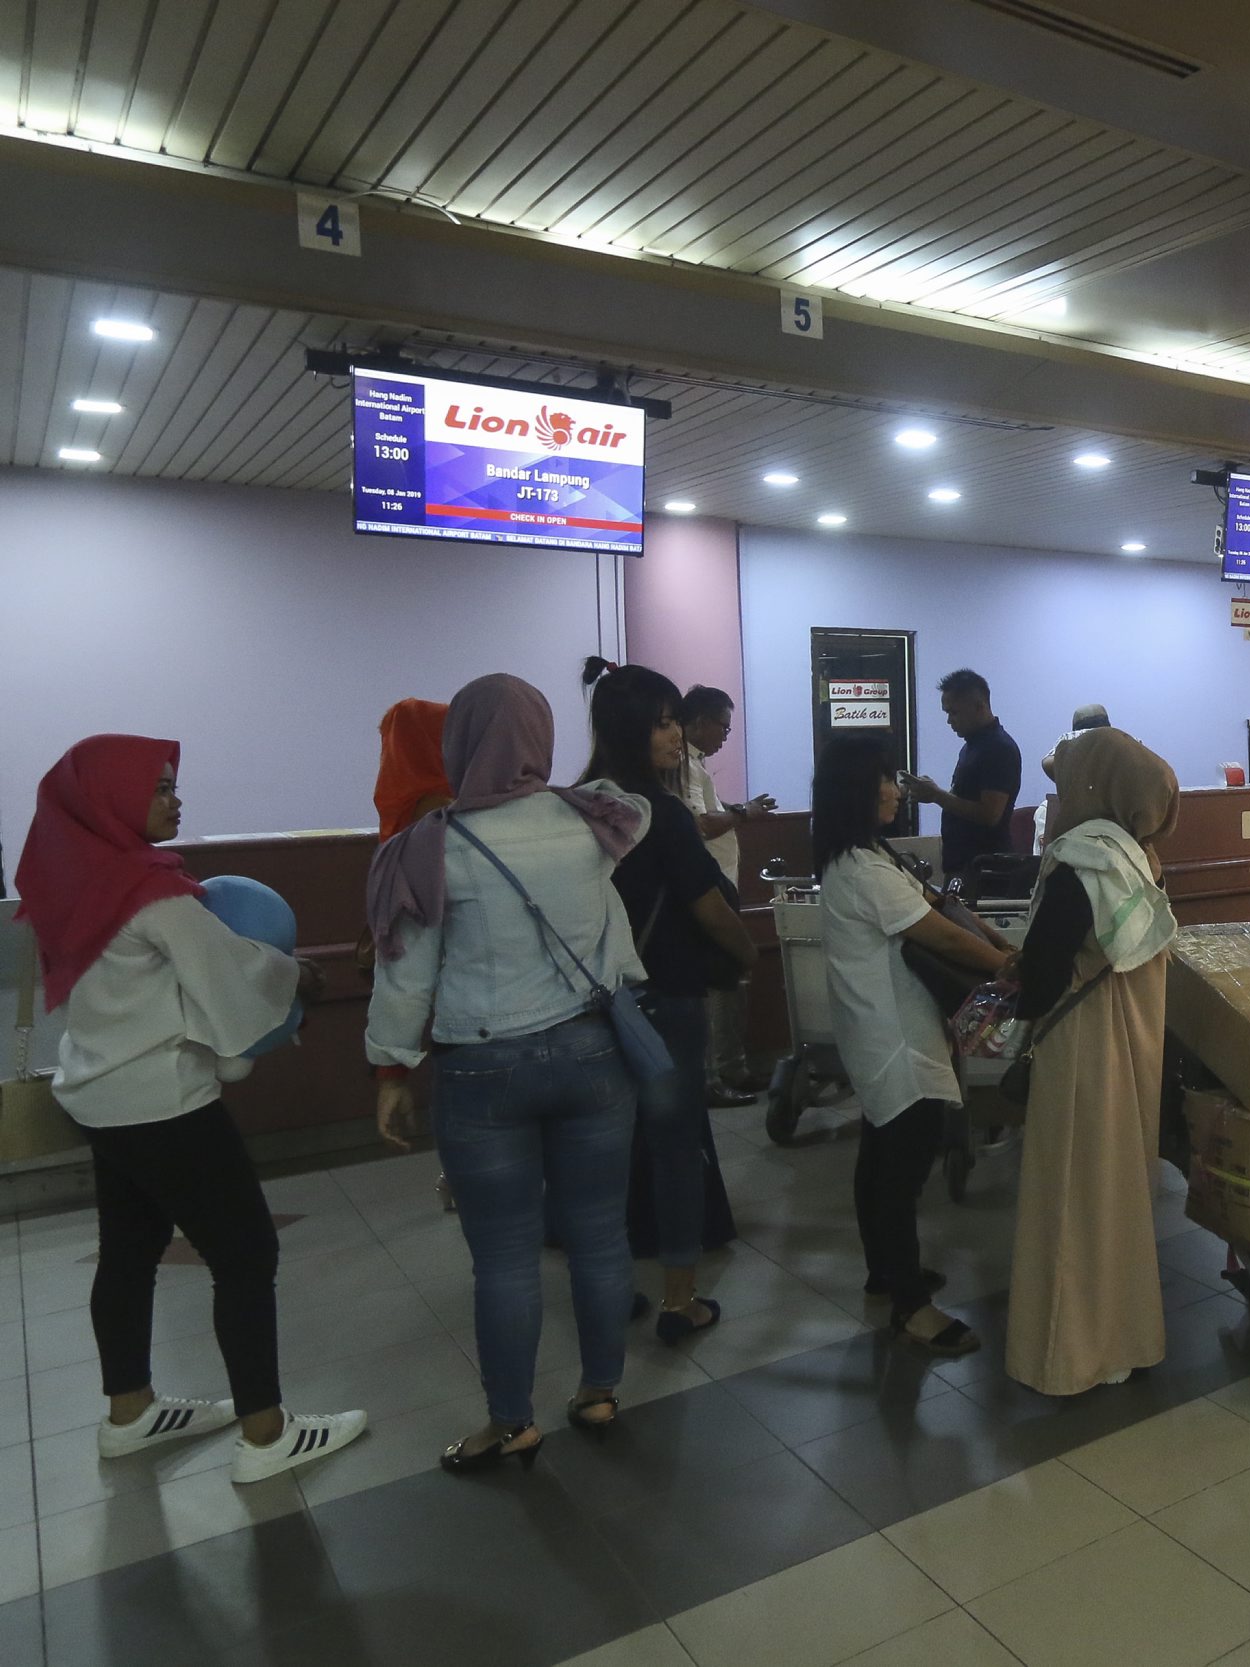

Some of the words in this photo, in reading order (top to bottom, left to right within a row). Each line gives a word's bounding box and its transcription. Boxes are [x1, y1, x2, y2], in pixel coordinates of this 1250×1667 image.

[316, 204, 344, 247] 4
[794, 297, 812, 332] 5
[369, 389, 388, 401] Hang
[389, 392, 413, 403] Nadim
[355, 398, 401, 412] International
[401, 404, 425, 415] Airport
[379, 411, 403, 422] Batam
[444, 404, 530, 437] Lion
[577, 423, 627, 449] air
[375, 432, 408, 444] Schedule
[373, 444, 410, 461] 13:00
[486, 463, 532, 482] Bandar
[533, 468, 591, 489] Lampung
[361, 486, 387, 496] Tuesday,
[516, 486, 559, 502] JT-173
[381, 501, 403, 512] 11:26
[509, 512, 536, 523] CHECK
[536, 515, 546, 523] IN
[546, 516, 568, 526] OPEN
[831, 687, 851, 695] Lion
[863, 688, 887, 697] Group
[834, 706, 867, 720] Batik
[869, 709, 887, 720] air
